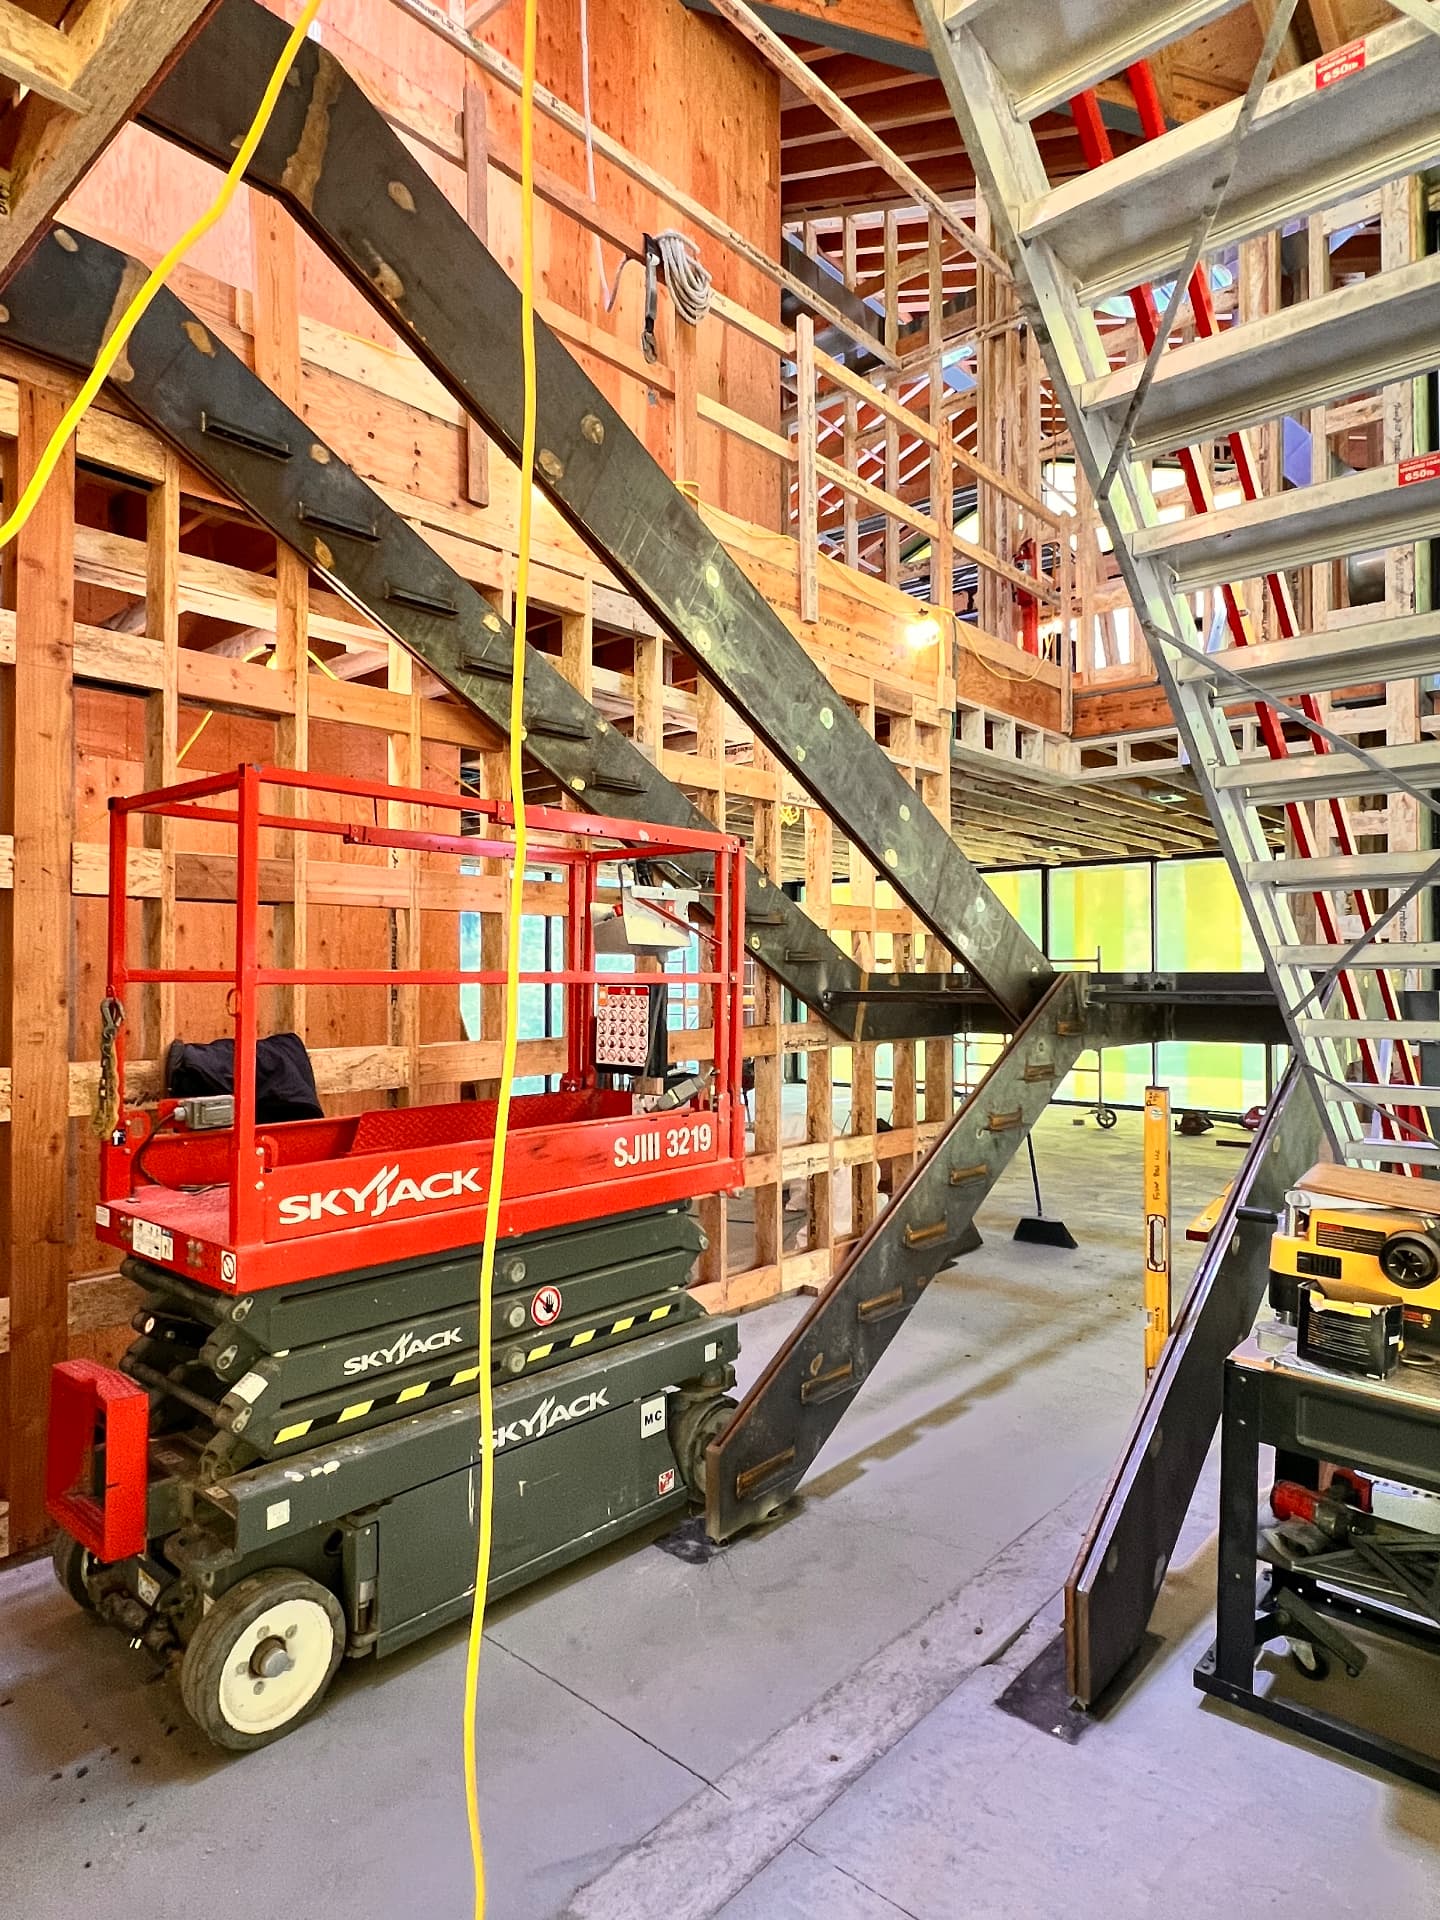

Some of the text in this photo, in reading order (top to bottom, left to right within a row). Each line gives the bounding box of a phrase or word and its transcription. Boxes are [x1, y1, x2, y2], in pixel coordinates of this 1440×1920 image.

[613, 1123, 712, 1168] SJIII 3219
[278, 1163, 483, 1225] SKYJACK
[343, 1327, 463, 1376] SKYJACK
[644, 1410, 662, 1427] MC
